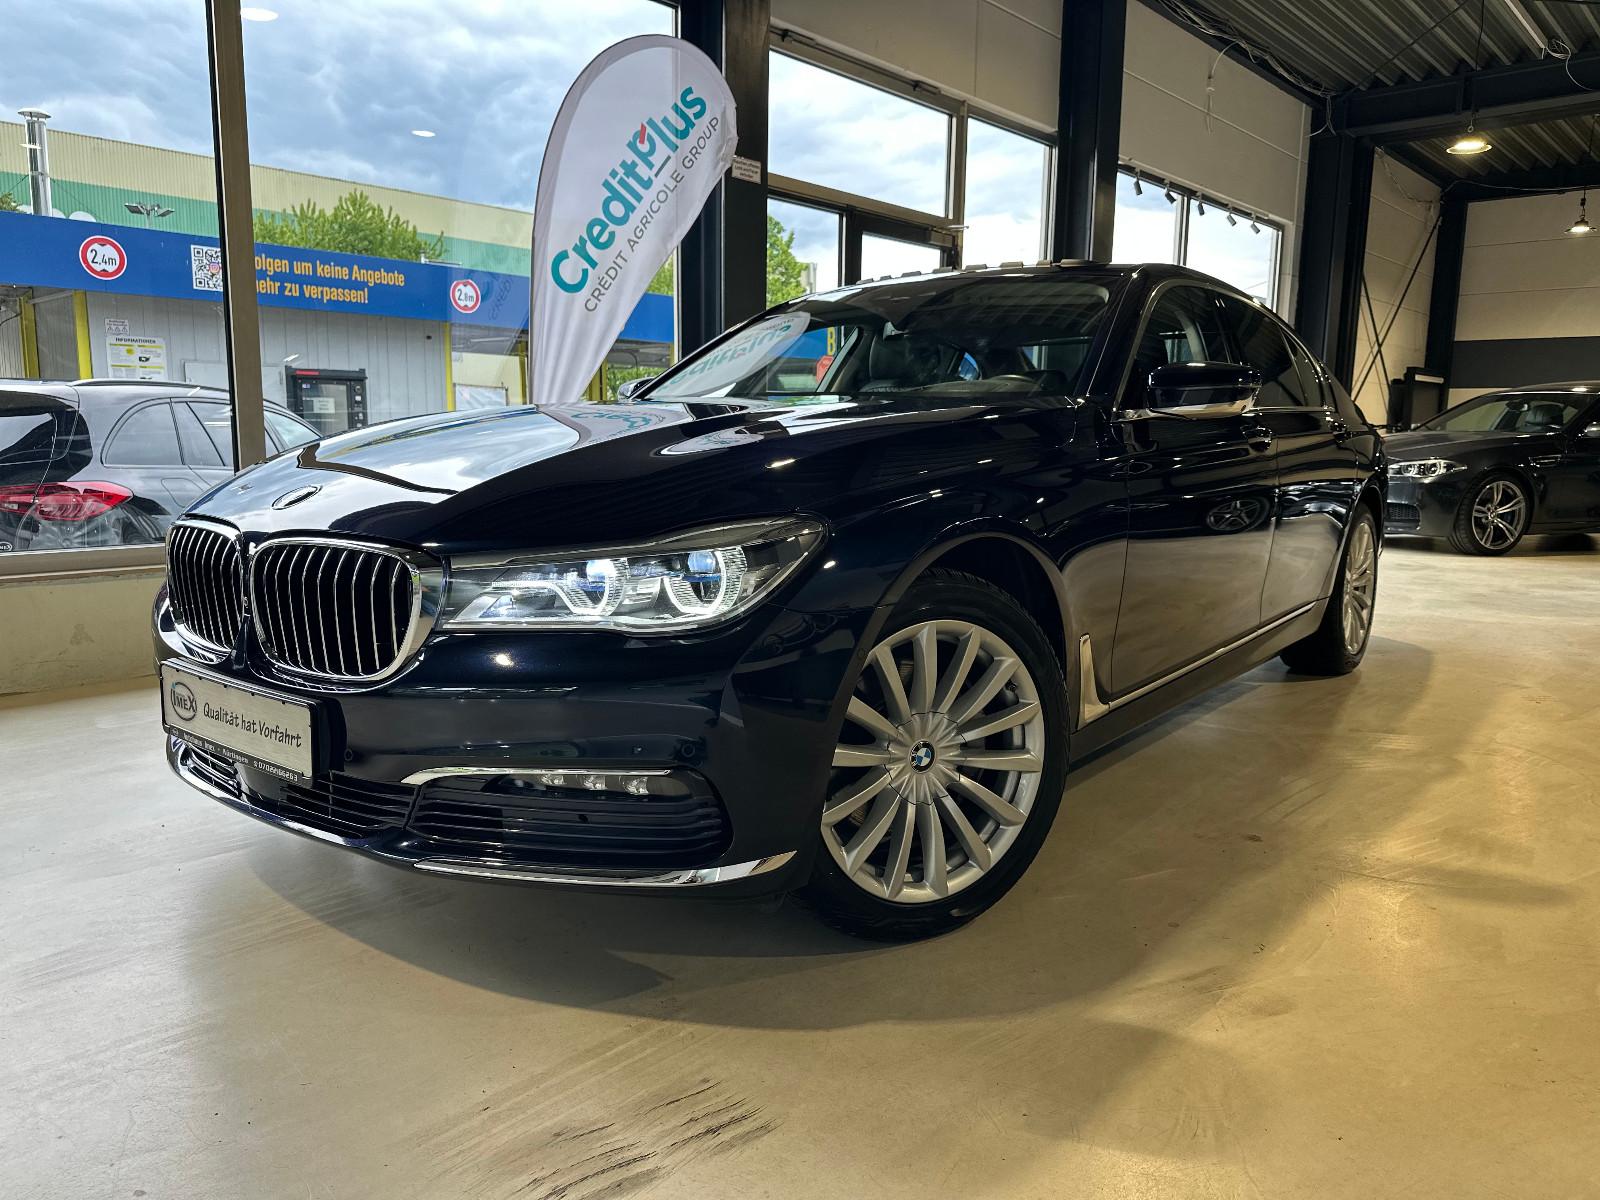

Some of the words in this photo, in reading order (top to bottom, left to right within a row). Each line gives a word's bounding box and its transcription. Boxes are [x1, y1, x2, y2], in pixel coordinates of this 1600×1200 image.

[584, 250, 628, 312] CRÉDIT
[627, 170, 684, 252] AGRICOLE
[682, 116, 719, 170] GROUP
[255, 253, 289, 275] olgen
[294, 260, 312, 276] um
[316, 260, 349, 279] keine
[352, 264, 405, 286] Angebote
[255, 277, 280, 294] ehr
[284, 282, 299, 297] zu
[303, 284, 369, 303] verpassen!
[203, 702, 240, 727] Qualität
[241, 714, 257, 734] hat
[258, 720, 302, 748] Vorfahrt
